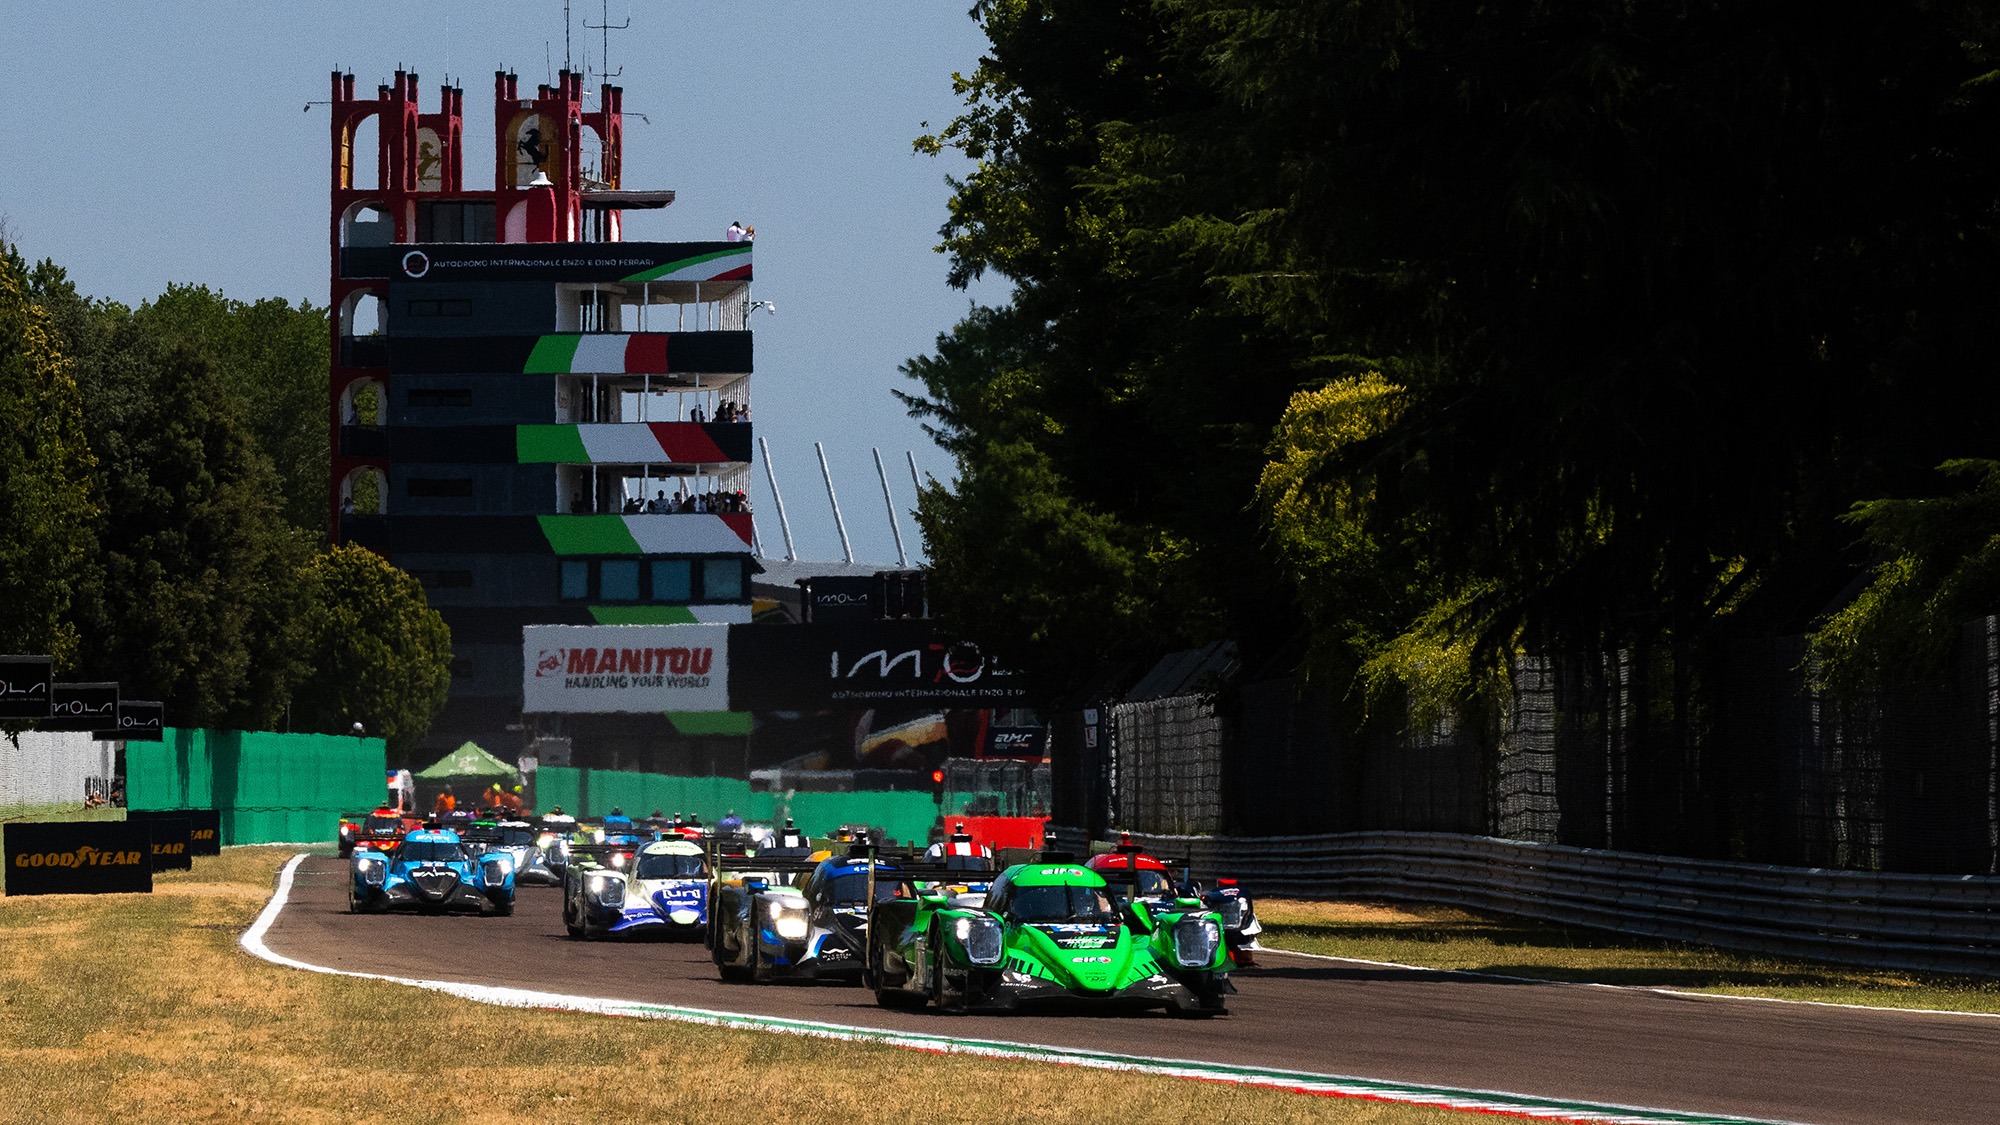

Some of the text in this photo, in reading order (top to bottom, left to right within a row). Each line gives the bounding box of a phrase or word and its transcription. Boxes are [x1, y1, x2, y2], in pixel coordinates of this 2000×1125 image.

[433, 260, 488, 268] AUTODROMO
[490, 259, 560, 267] INTERNAZIONALE
[562, 259, 586, 267] ENZO
[595, 259, 617, 267] DINO
[567, 647, 713, 675] MANITOU
[565, 675, 710, 689] HANDLING YOUR WORLD
[151, 843, 185, 855] EAR
[15, 846, 142, 868] GOODYEAR
